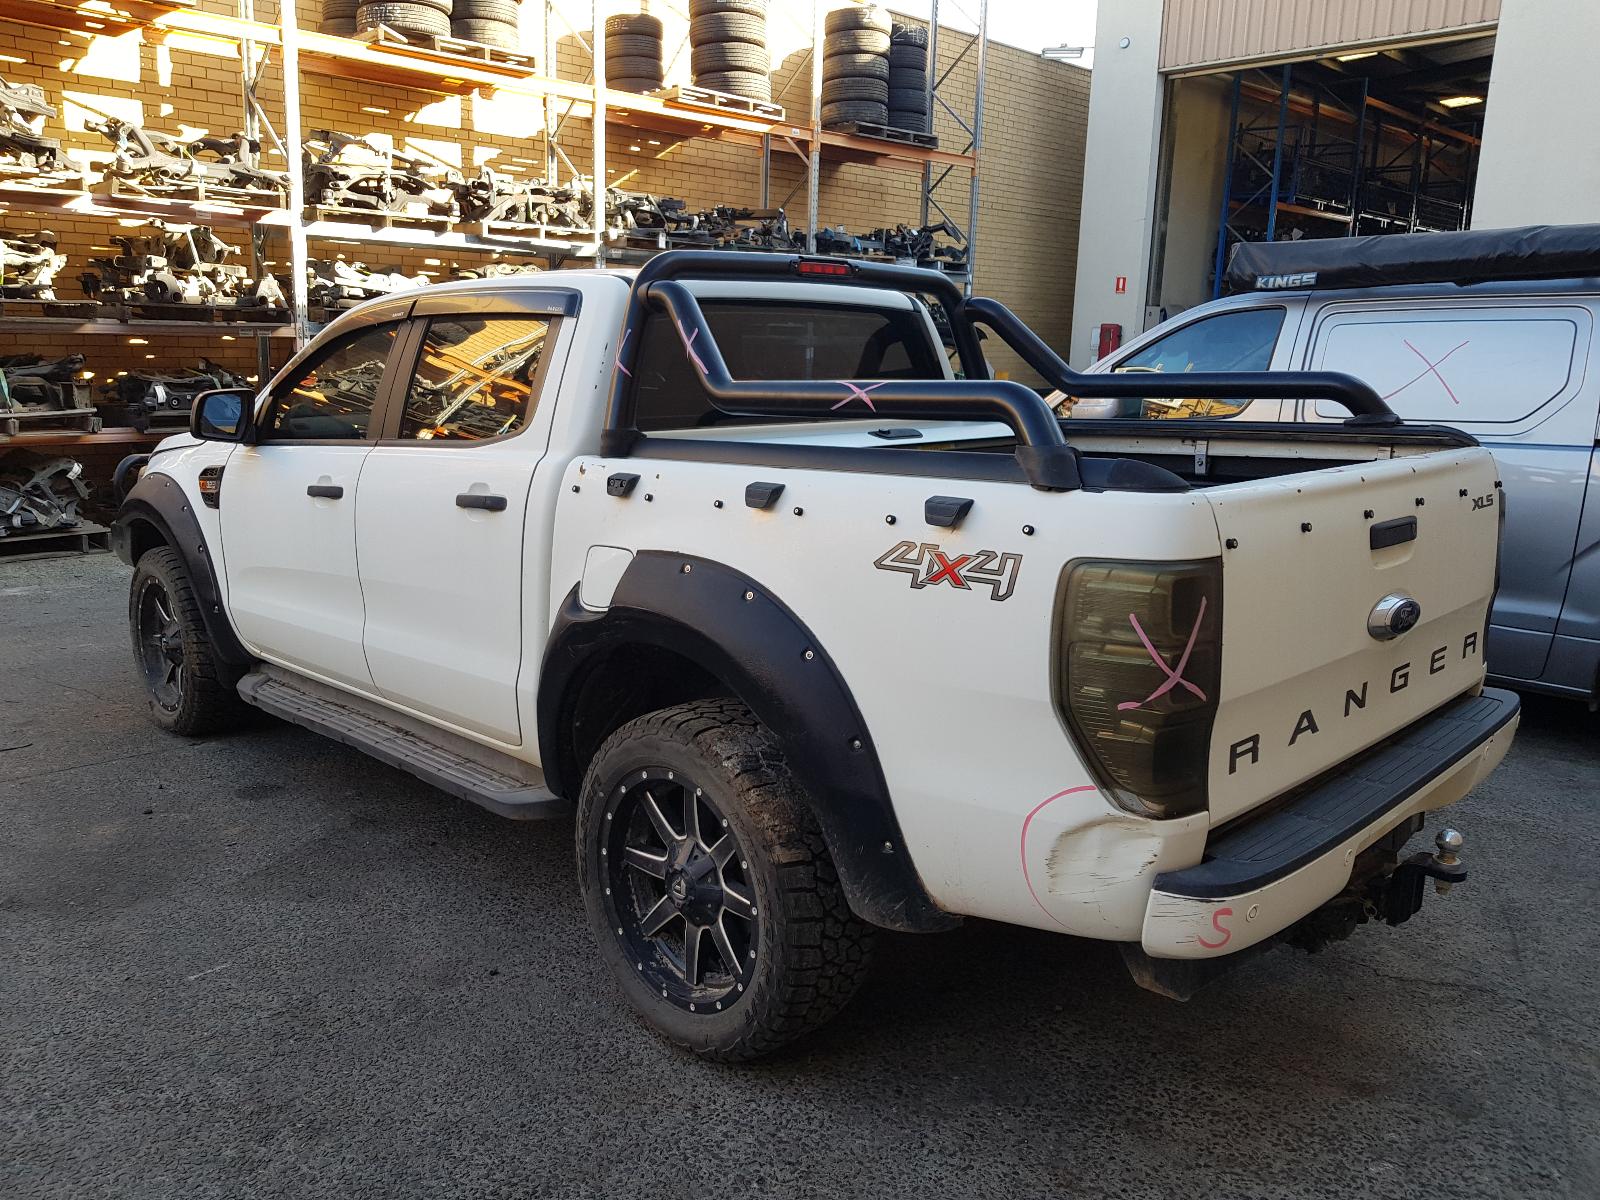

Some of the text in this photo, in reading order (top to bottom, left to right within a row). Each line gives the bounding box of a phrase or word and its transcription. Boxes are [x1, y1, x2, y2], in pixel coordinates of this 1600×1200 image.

[1256, 272, 1317, 288] KINGS
[1471, 493, 1494, 511] XLS
[1228, 631, 1478, 775] RANGER
